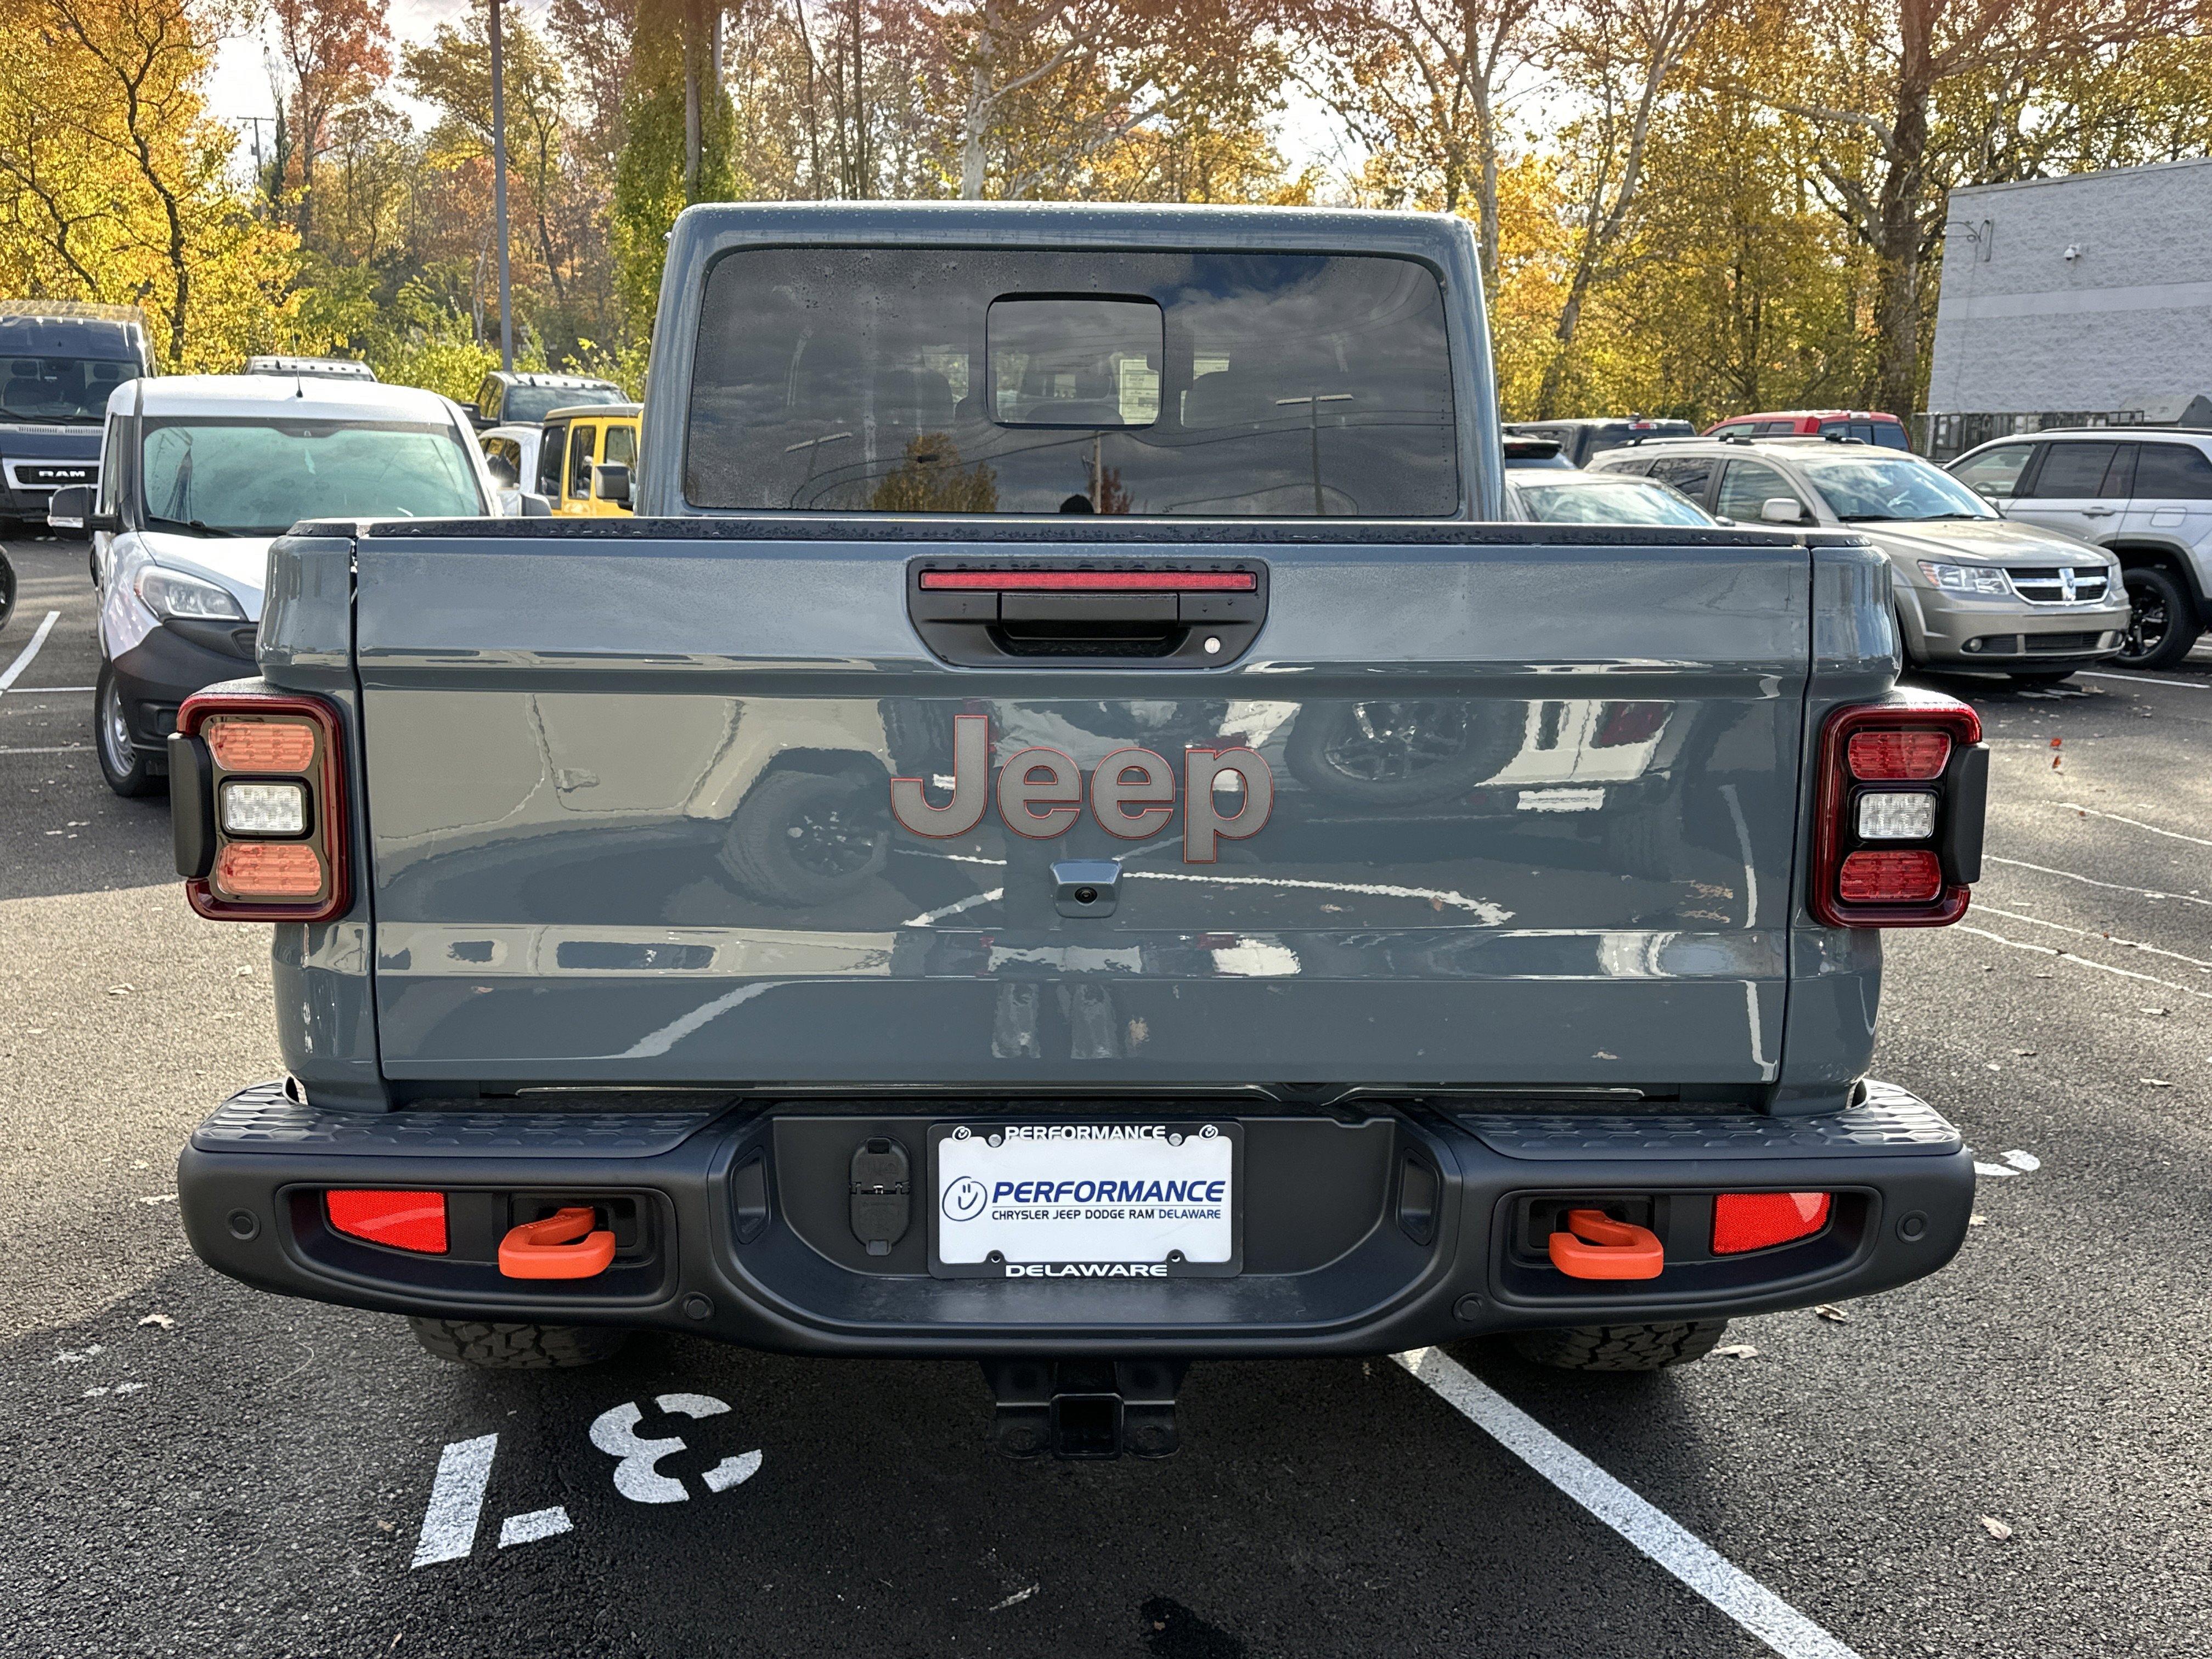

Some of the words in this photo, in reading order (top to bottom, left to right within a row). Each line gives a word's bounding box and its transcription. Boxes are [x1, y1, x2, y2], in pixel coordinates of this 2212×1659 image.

[890, 715, 1274, 864] Jeep
[1005, 1125, 1166, 1140] PERFORMANCE
[992, 1180, 1226, 1204] PERFORMANCE
[992, 1210, 1049, 1220] CHRYSLER
[1053, 1210, 1081, 1220] JEEP
[1085, 1209, 1125, 1219] DODGE
[1129, 1209, 1155, 1219] RAM
[1159, 1209, 1221, 1219] DELAWARE
[1005, 1264, 1167, 1277] DELAWARE
